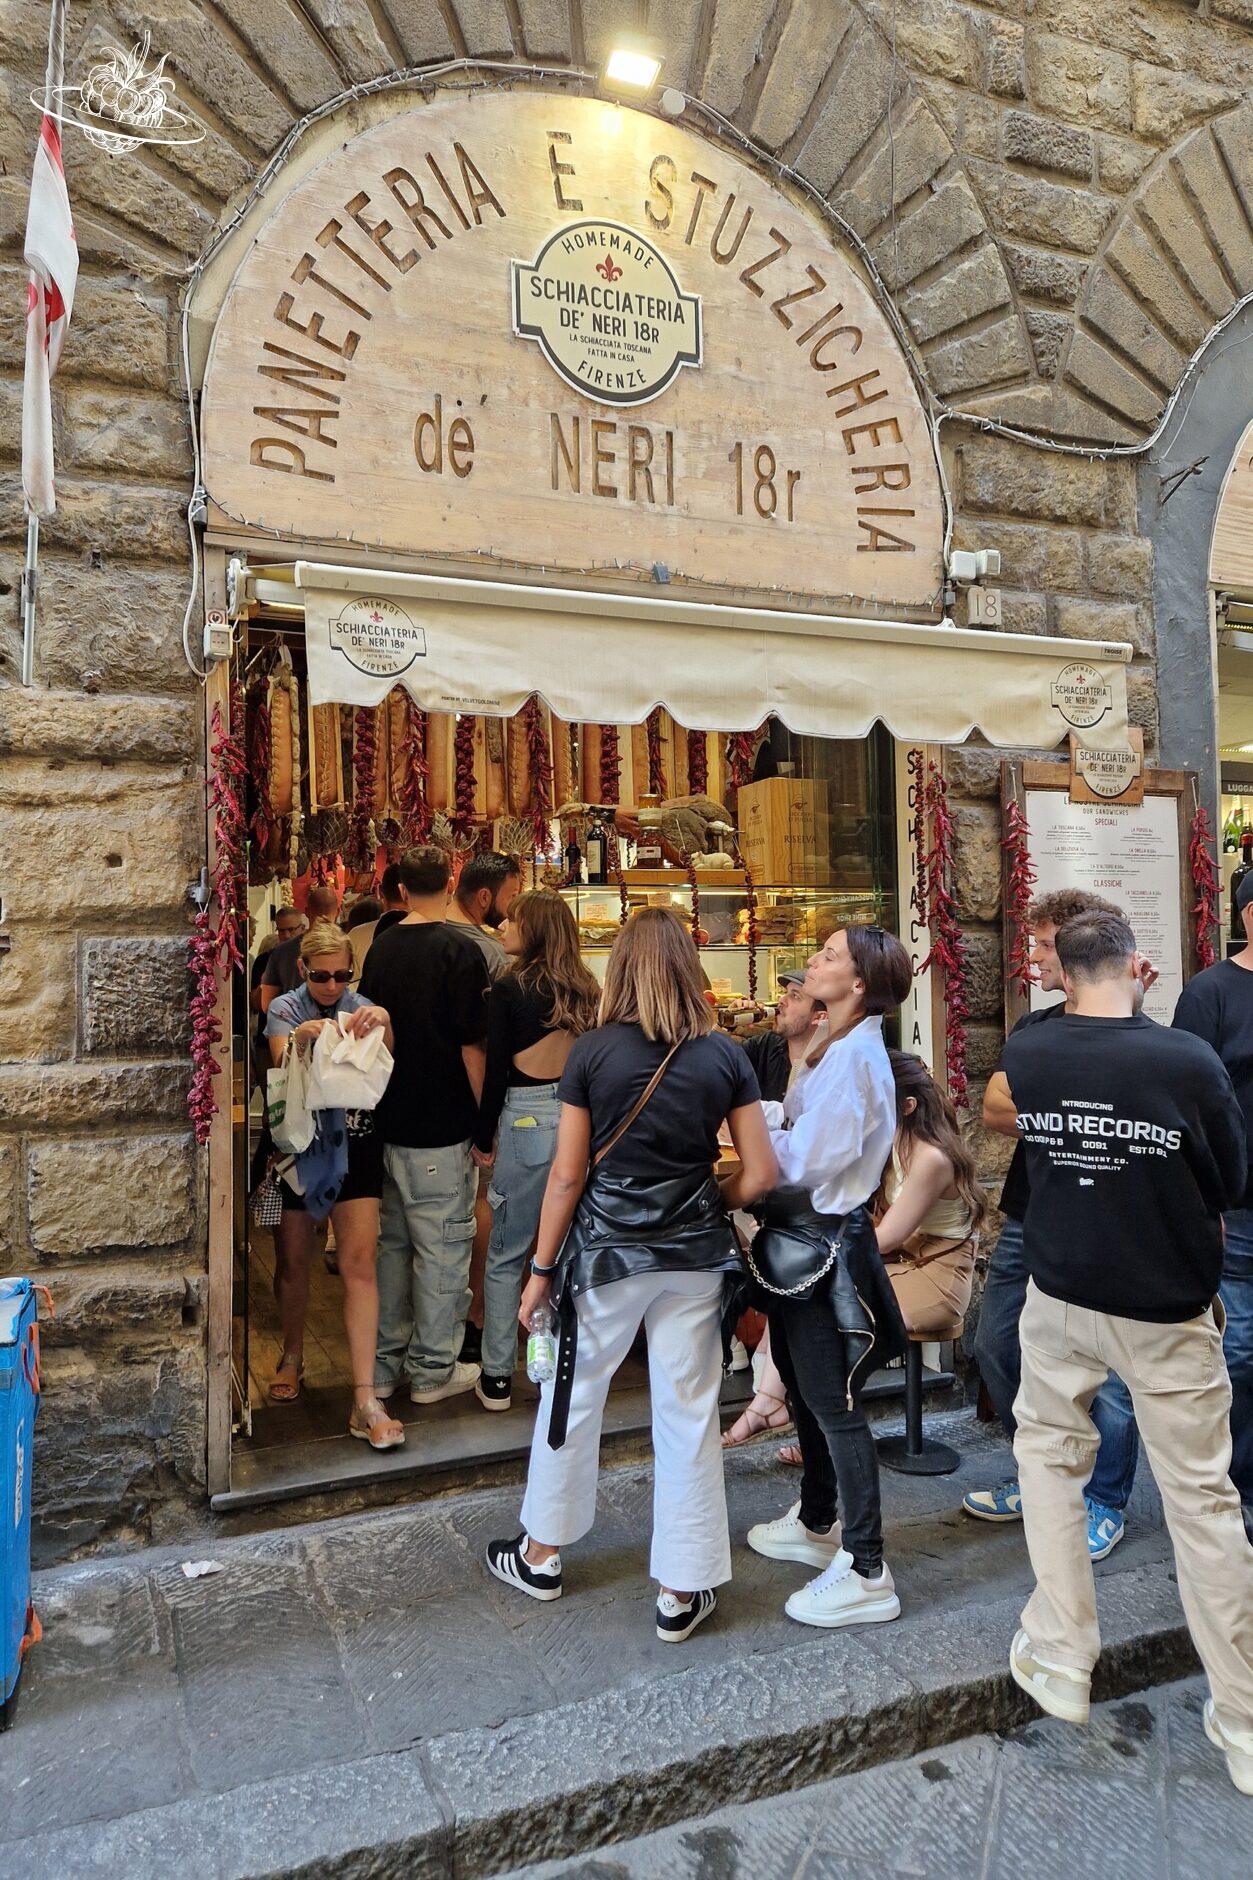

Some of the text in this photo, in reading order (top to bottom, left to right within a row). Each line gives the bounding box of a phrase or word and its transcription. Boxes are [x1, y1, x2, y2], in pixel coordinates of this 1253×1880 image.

[561, 231, 654, 269] HOMEMADE
[530, 276, 686, 325] SCHIACCIATERIA
[560, 308, 660, 344] DE' NERI 18R
[250, 131, 916, 553] PANETTERIA E STUZZICHERIA
[569, 333, 652, 355] LA SCHIACCIATA TOSCANA
[587, 348, 635, 363] FATTA IN CASA
[577, 360, 647, 389] FIRENZE
[551, 412, 675, 506] NERI
[727, 441, 801, 522] 18r
[352, 600, 401, 617] HOMEMADE
[976, 594, 998, 618] 18
[336, 622, 419, 640] SCHIACCIATERIA
[368, 637, 388, 648] NERI
[361, 661, 399, 672] FIRENZE
[1055, 685, 1107, 697] SCHIACCIATERIA
[1075, 696, 1088, 705] NERI
[1070, 714, 1096, 725] FIRENZE
[1080, 751, 1137, 764] SCHIACCIATERIA
[1101, 763, 1115, 773] NERI
[1095, 784, 1122, 795] FIRENZE
[1095, 809, 1129, 817] SANDWICHES
[1094, 818, 1118, 827] SPECIALI
[1061, 1100, 1114, 1111] INTRODUCING
[1068, 1114, 1182, 1151] RECORDS
[1049, 1151, 1111, 1163] ENTERTAINMENT
[1097, 1164, 1122, 1172] QUALITY
